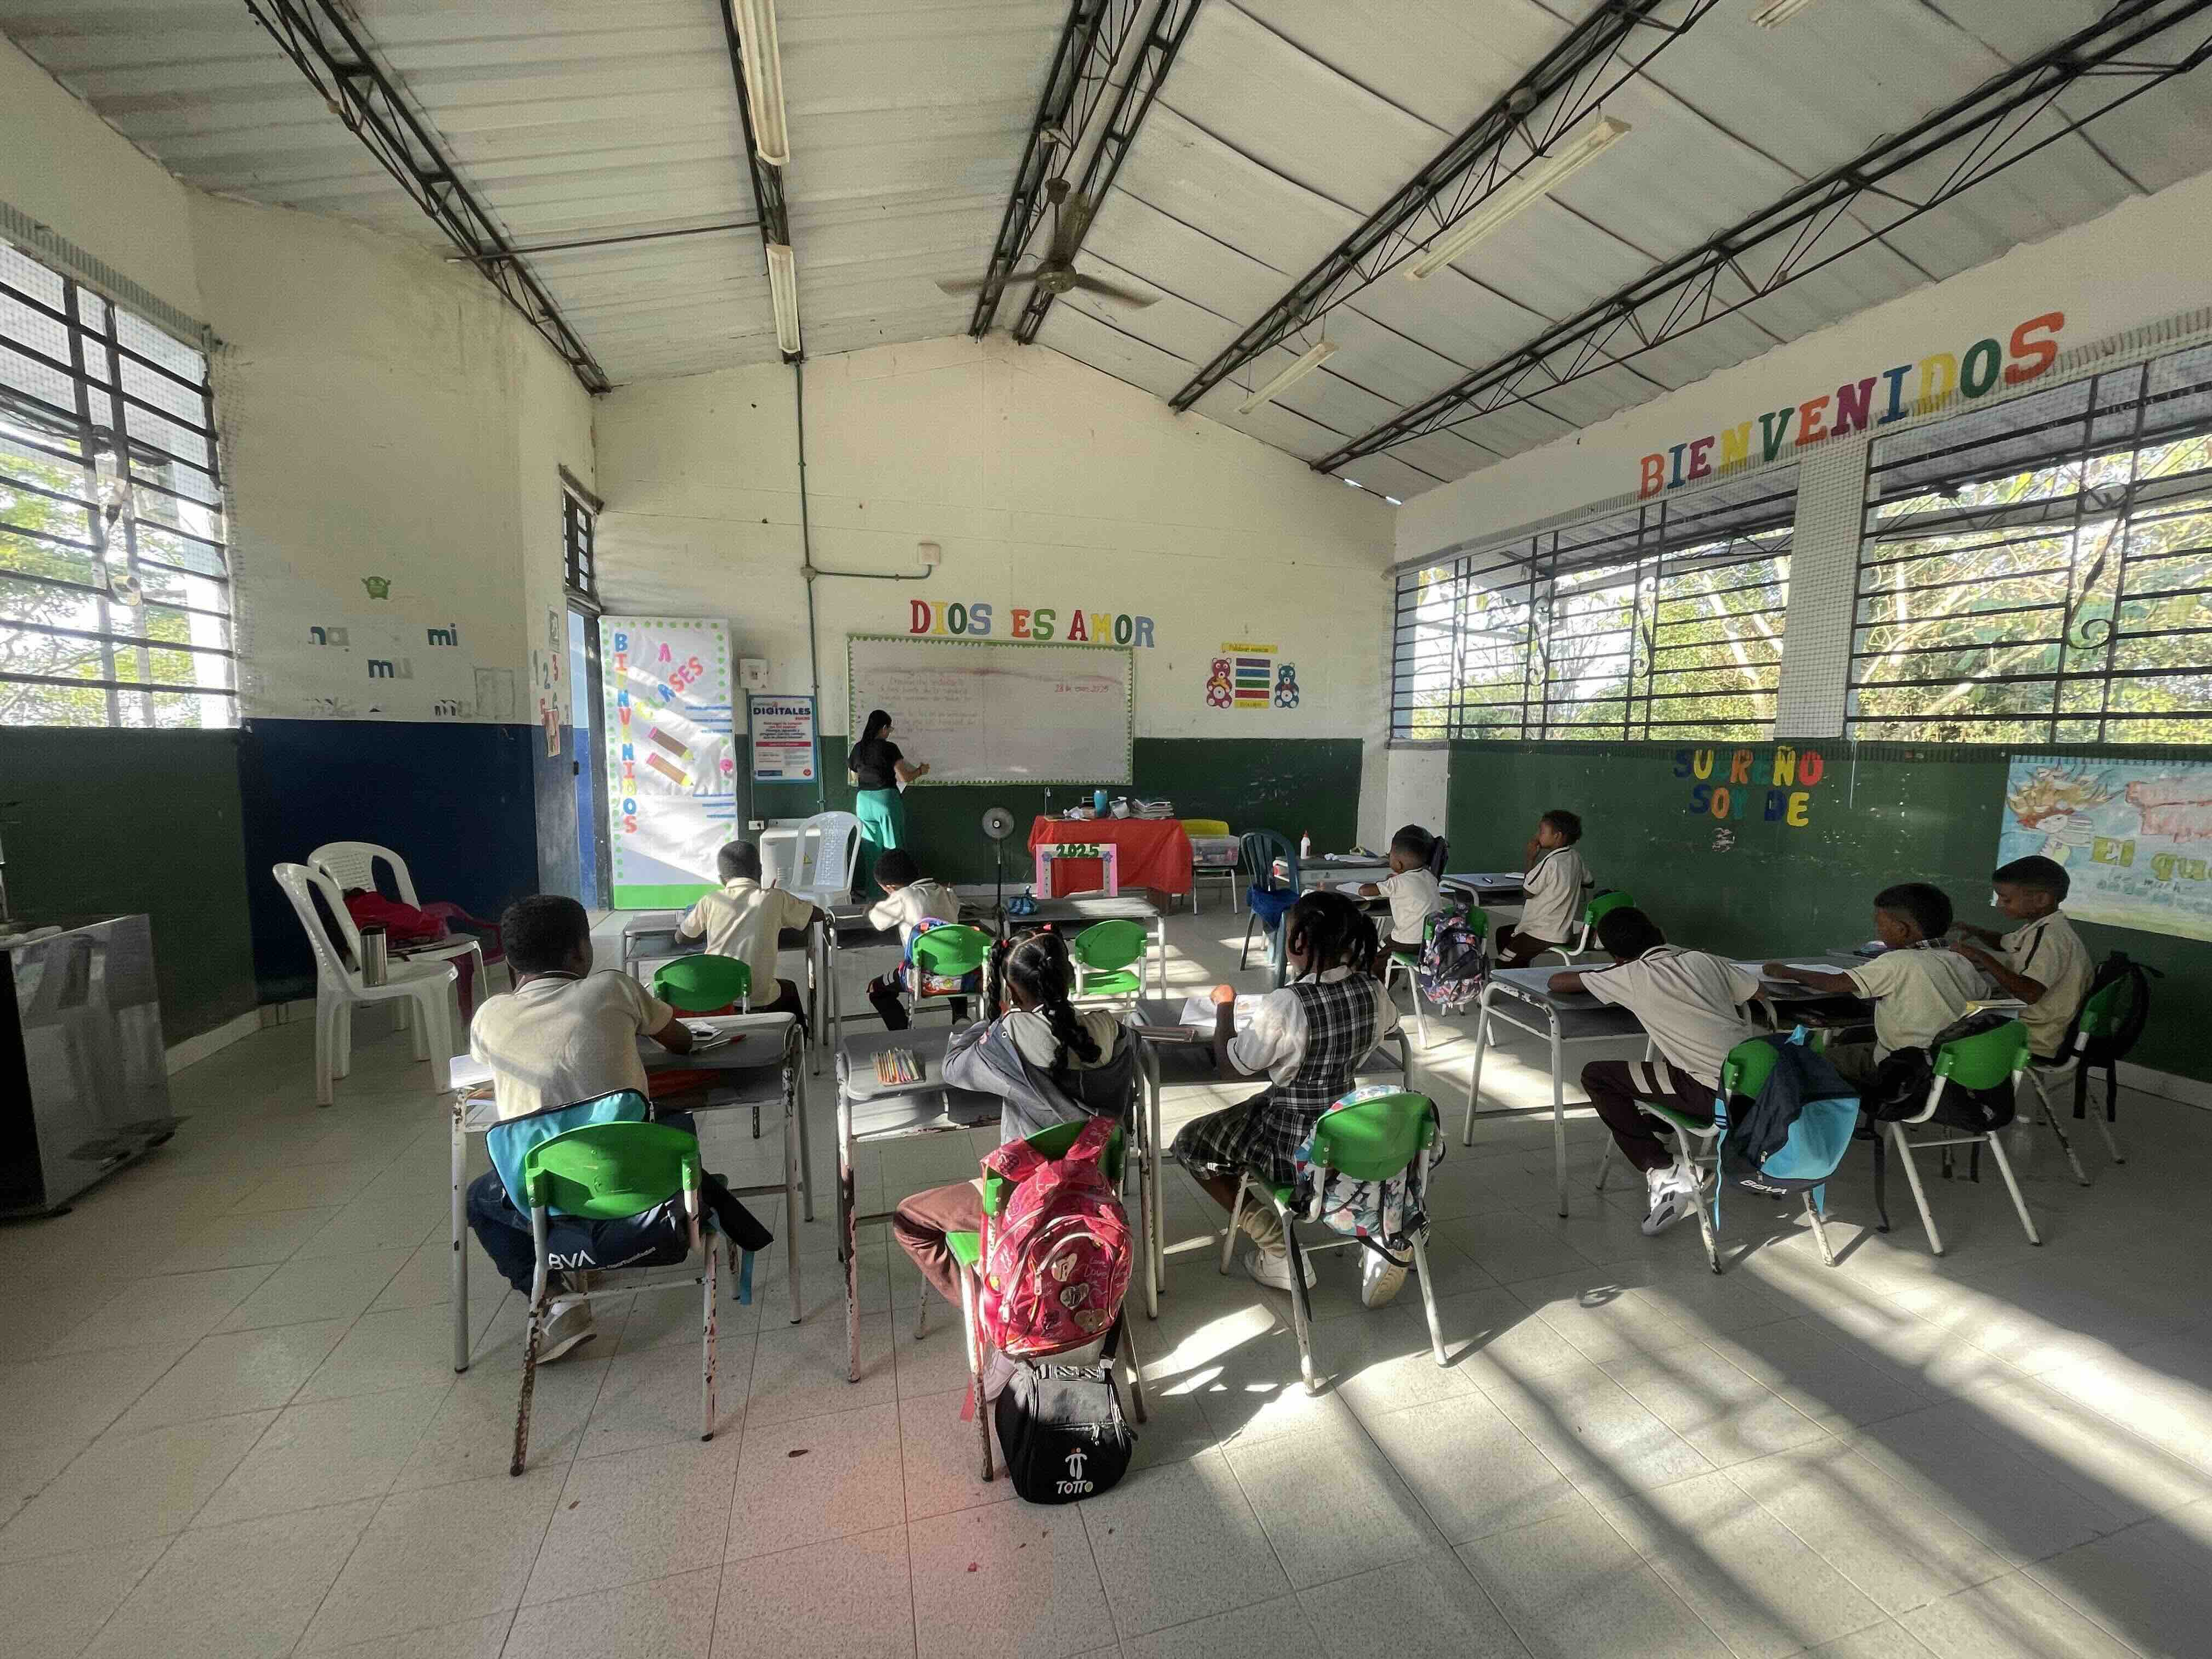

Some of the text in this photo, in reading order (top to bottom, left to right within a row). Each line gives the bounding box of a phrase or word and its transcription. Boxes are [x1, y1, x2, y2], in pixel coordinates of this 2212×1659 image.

[1637, 311, 2064, 500] BIENVENIDOS
[427, 623, 458, 646] mi
[908, 600, 1155, 648] DIOS ES AMOR
[658, 642, 672, 663] A
[753, 707, 811, 715] DIGITALES
[1689, 783, 1810, 827] SOY DE
[1056, 843, 1100, 858] 2025
[2151, 851, 2212, 882] qu
[549, 1250, 596, 1270] BVA
[1056, 1480, 1093, 1494] TOTTO
